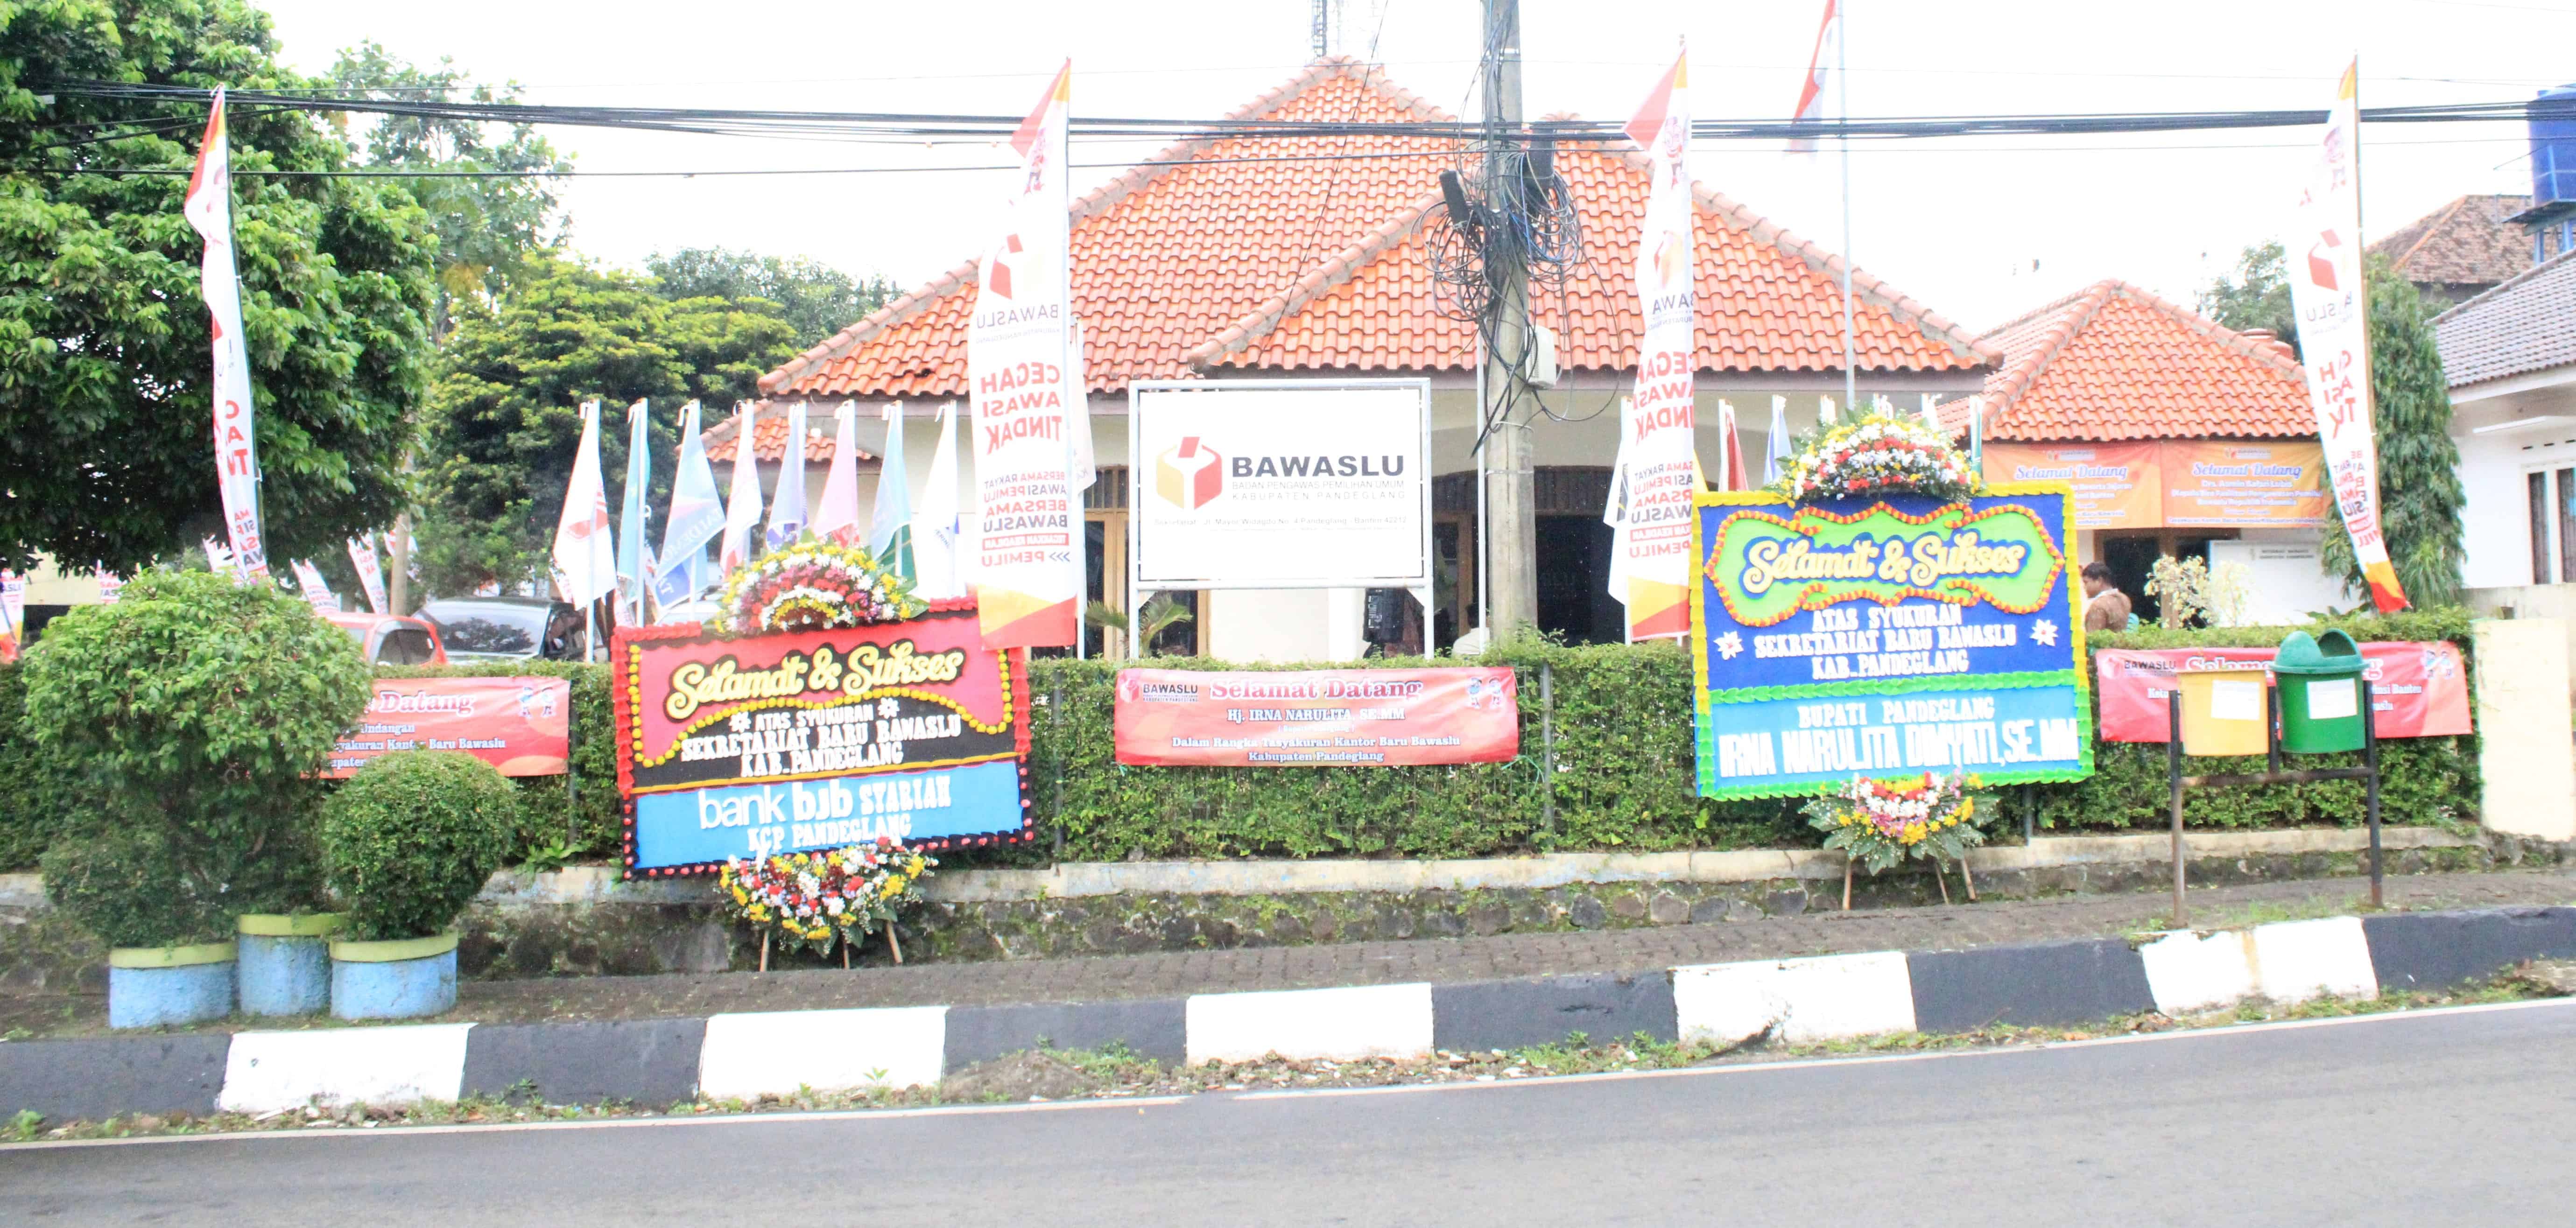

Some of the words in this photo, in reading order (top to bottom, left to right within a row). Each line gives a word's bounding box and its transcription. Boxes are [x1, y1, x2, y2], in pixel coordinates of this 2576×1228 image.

[1232, 456, 1403, 477] BAWASLU
[2077, 464, 2128, 481] Datang
[2252, 463, 2302, 479] Datang
[1232, 481, 1264, 490] BADAN
[1267, 480, 1320, 490] PENGAWAS
[1323, 480, 1372, 489] PEMILIHAN
[1375, 480, 1404, 489] UMUM
[1232, 492, 1309, 500] KABUPATEN
[1317, 491, 1405, 500] PANDEGLANG
[1743, 540, 1880, 594] Selamat
[1879, 535, 1909, 582] &
[1910, 531, 2026, 587] Sukses
[1812, 609, 1858, 632] ATAS
[1868, 604, 1962, 630] SYUKURAN
[1755, 632, 1879, 658] SEKRETARIAT
[1885, 628, 1931, 652] BARU
[1937, 624, 2016, 648] BAWASLU
[2125, 660, 2176, 670] BAWASLU
[667, 655, 808, 720] Selamat
[808, 647, 841, 691] &
[842, 640, 964, 696] Sukses
[1143, 684, 1198, 694] BAWASLU
[1211, 678, 1319, 700] Selamat
[1324, 678, 1423, 700] Datang
[379, 690, 475, 717] Datang
[1798, 703, 1867, 728] BUPATI
[1883, 697, 1995, 724] PANDEGLANG
[754, 711, 791, 732] ATAS
[796, 703, 874, 728] SYUKURAN
[1227, 709, 1246, 723] Hj.
[1249, 709, 1282, 722] IRNA
[429, 737, 456, 750] Baru
[457, 736, 506, 750] Bawaslu
[681, 728, 811, 762] SEKRETARIAT
[817, 722, 868, 749] BARU
[876, 714, 962, 741] BAWASLU
[1173, 737, 1210, 747] Dalam
[1213, 737, 1258, 749] Rangka
[1261, 737, 1331, 749] Tasyakuran
[1334, 737, 1377, 747] Kantor
[1379, 736, 1408, 747] Baru
[1411, 735, 1461, 746] Bawaslu
[1248, 751, 1313, 763] Kabupaten
[1315, 751, 1384, 763] Pandeglang
[1718, 733, 1776, 777] IRNA
[1782, 727, 1901, 773] NARULITA
[698, 785, 787, 829] bank
[860, 775, 951, 815] SYARIAH
[748, 826, 785, 852] KCP
[792, 813, 912, 848] PANDEGLANG
